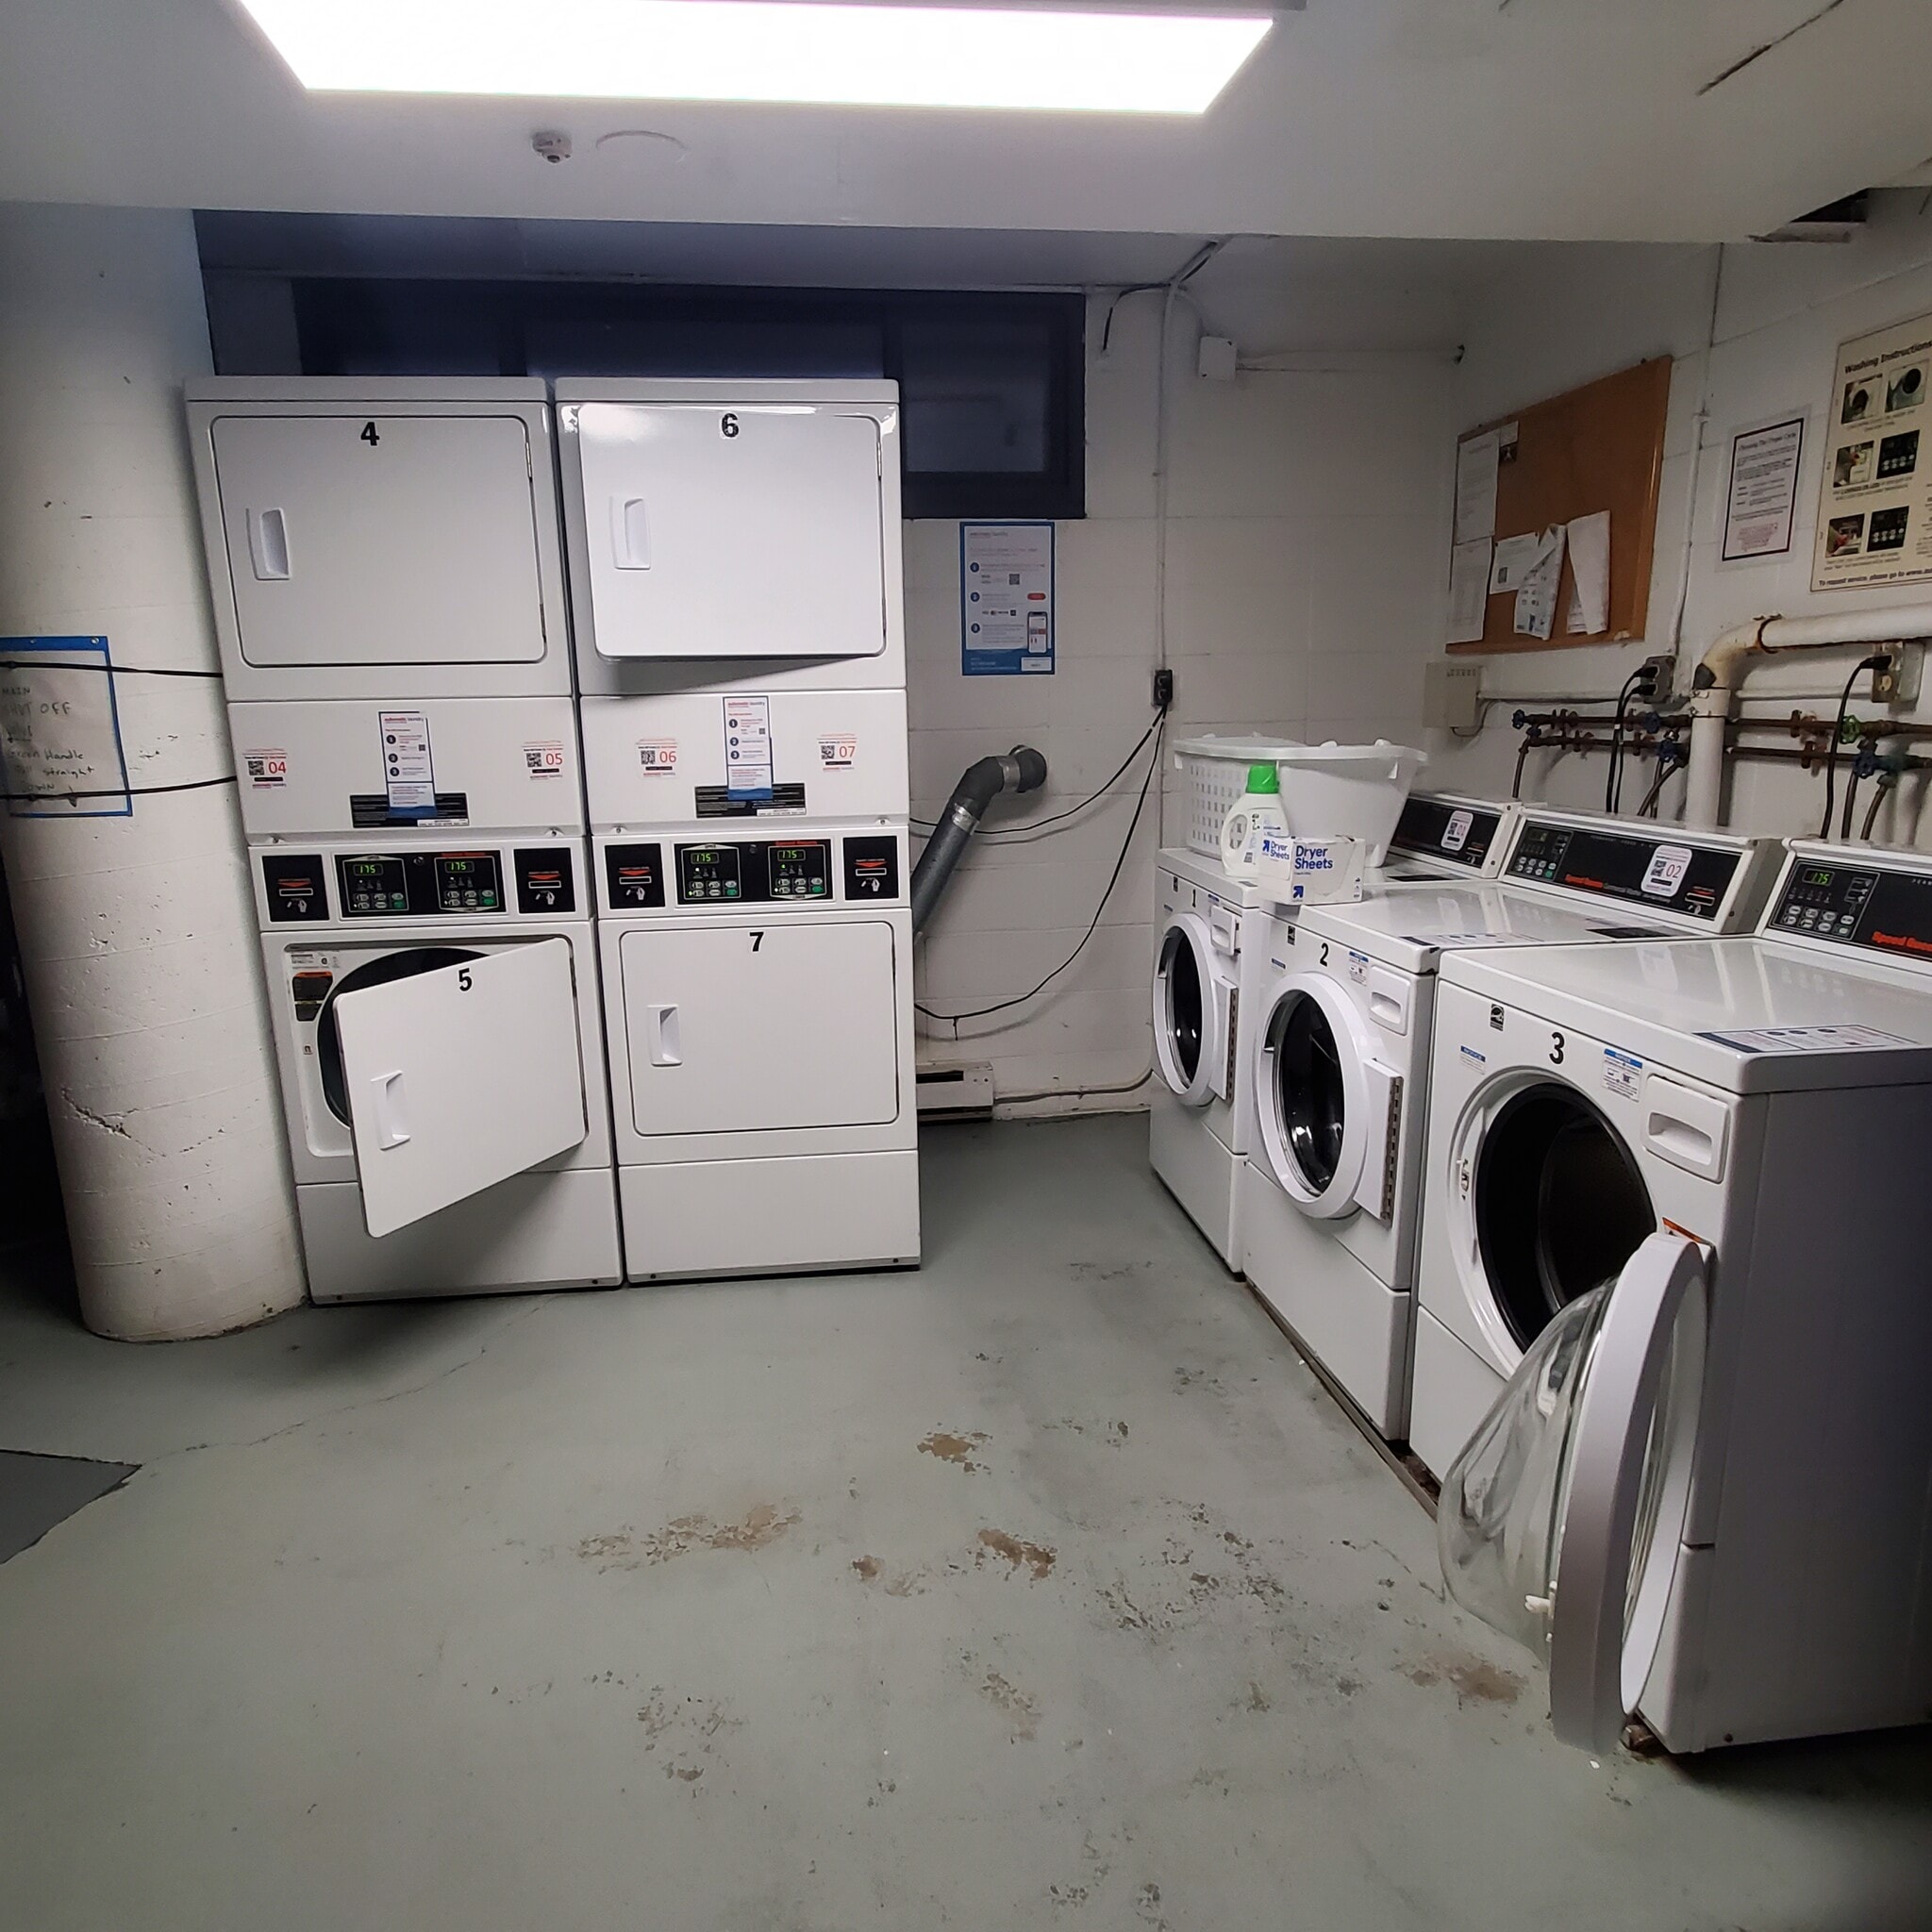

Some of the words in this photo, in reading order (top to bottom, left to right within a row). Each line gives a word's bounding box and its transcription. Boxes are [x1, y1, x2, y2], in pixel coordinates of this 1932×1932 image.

[1844, 358, 1879, 374] Washing
[722, 413, 740, 438] 6
[360, 421, 380, 446] 4
[40, 701, 72, 715] OFF
[44, 748, 84, 760] Handle
[659, 751, 677, 763] 06
[839, 745, 856, 758] 07
[545, 753, 563, 765] 05
[268, 761, 287, 774] 04
[1270, 841, 1289, 852] Dryer
[1295, 844, 1329, 860] Dryer
[696, 853, 711, 862] 175
[782, 850, 798, 858] 175
[1270, 849, 1290, 860] Sheets
[359, 864, 375, 874] 175
[451, 861, 467, 871] 175
[1294, 858, 1334, 870] Sheets
[1665, 863, 1682, 879] 02
[1191, 889, 1196, 908] 1
[749, 931, 764, 952] 7
[1319, 942, 1329, 966] 2
[458, 967, 473, 992] 5
[1548, 1031, 1565, 1065] 3
